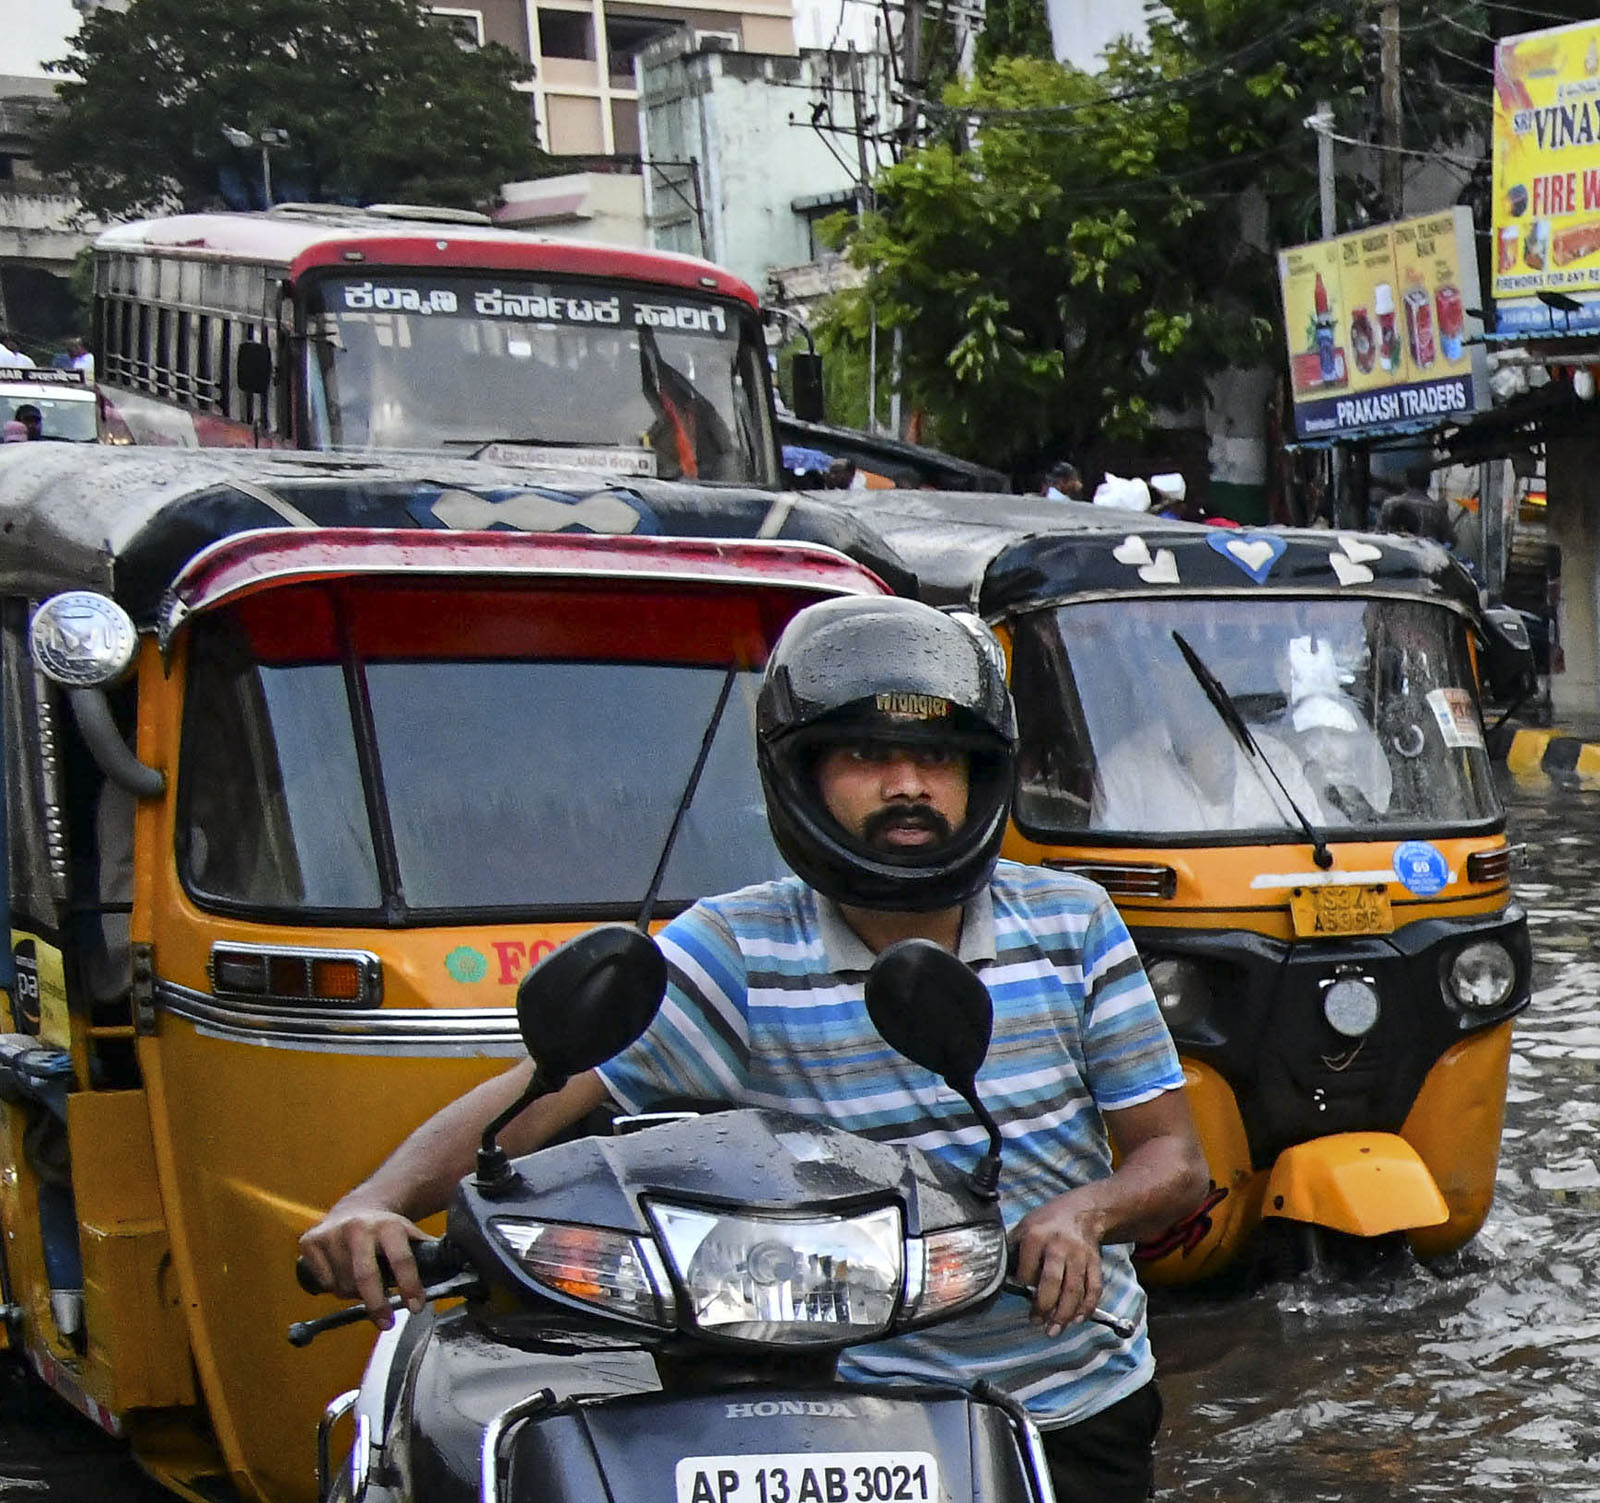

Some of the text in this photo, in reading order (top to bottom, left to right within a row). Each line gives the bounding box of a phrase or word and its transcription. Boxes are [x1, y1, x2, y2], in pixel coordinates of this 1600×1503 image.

[1533, 173, 1577, 217] FIRE
[344, 282, 727, 333] ಕಲ್ಯಾಣ ಕರ್ನಾಟಕ ಸಾರಿಗೆ
[1337, 393, 1400, 427] PRAKASH
[1400, 382, 1466, 416] TRADERS
[726, 1401, 855, 1418] HONDA
[798, 1467, 849, 1503] AB
[853, 1464, 928, 1502] 3021
